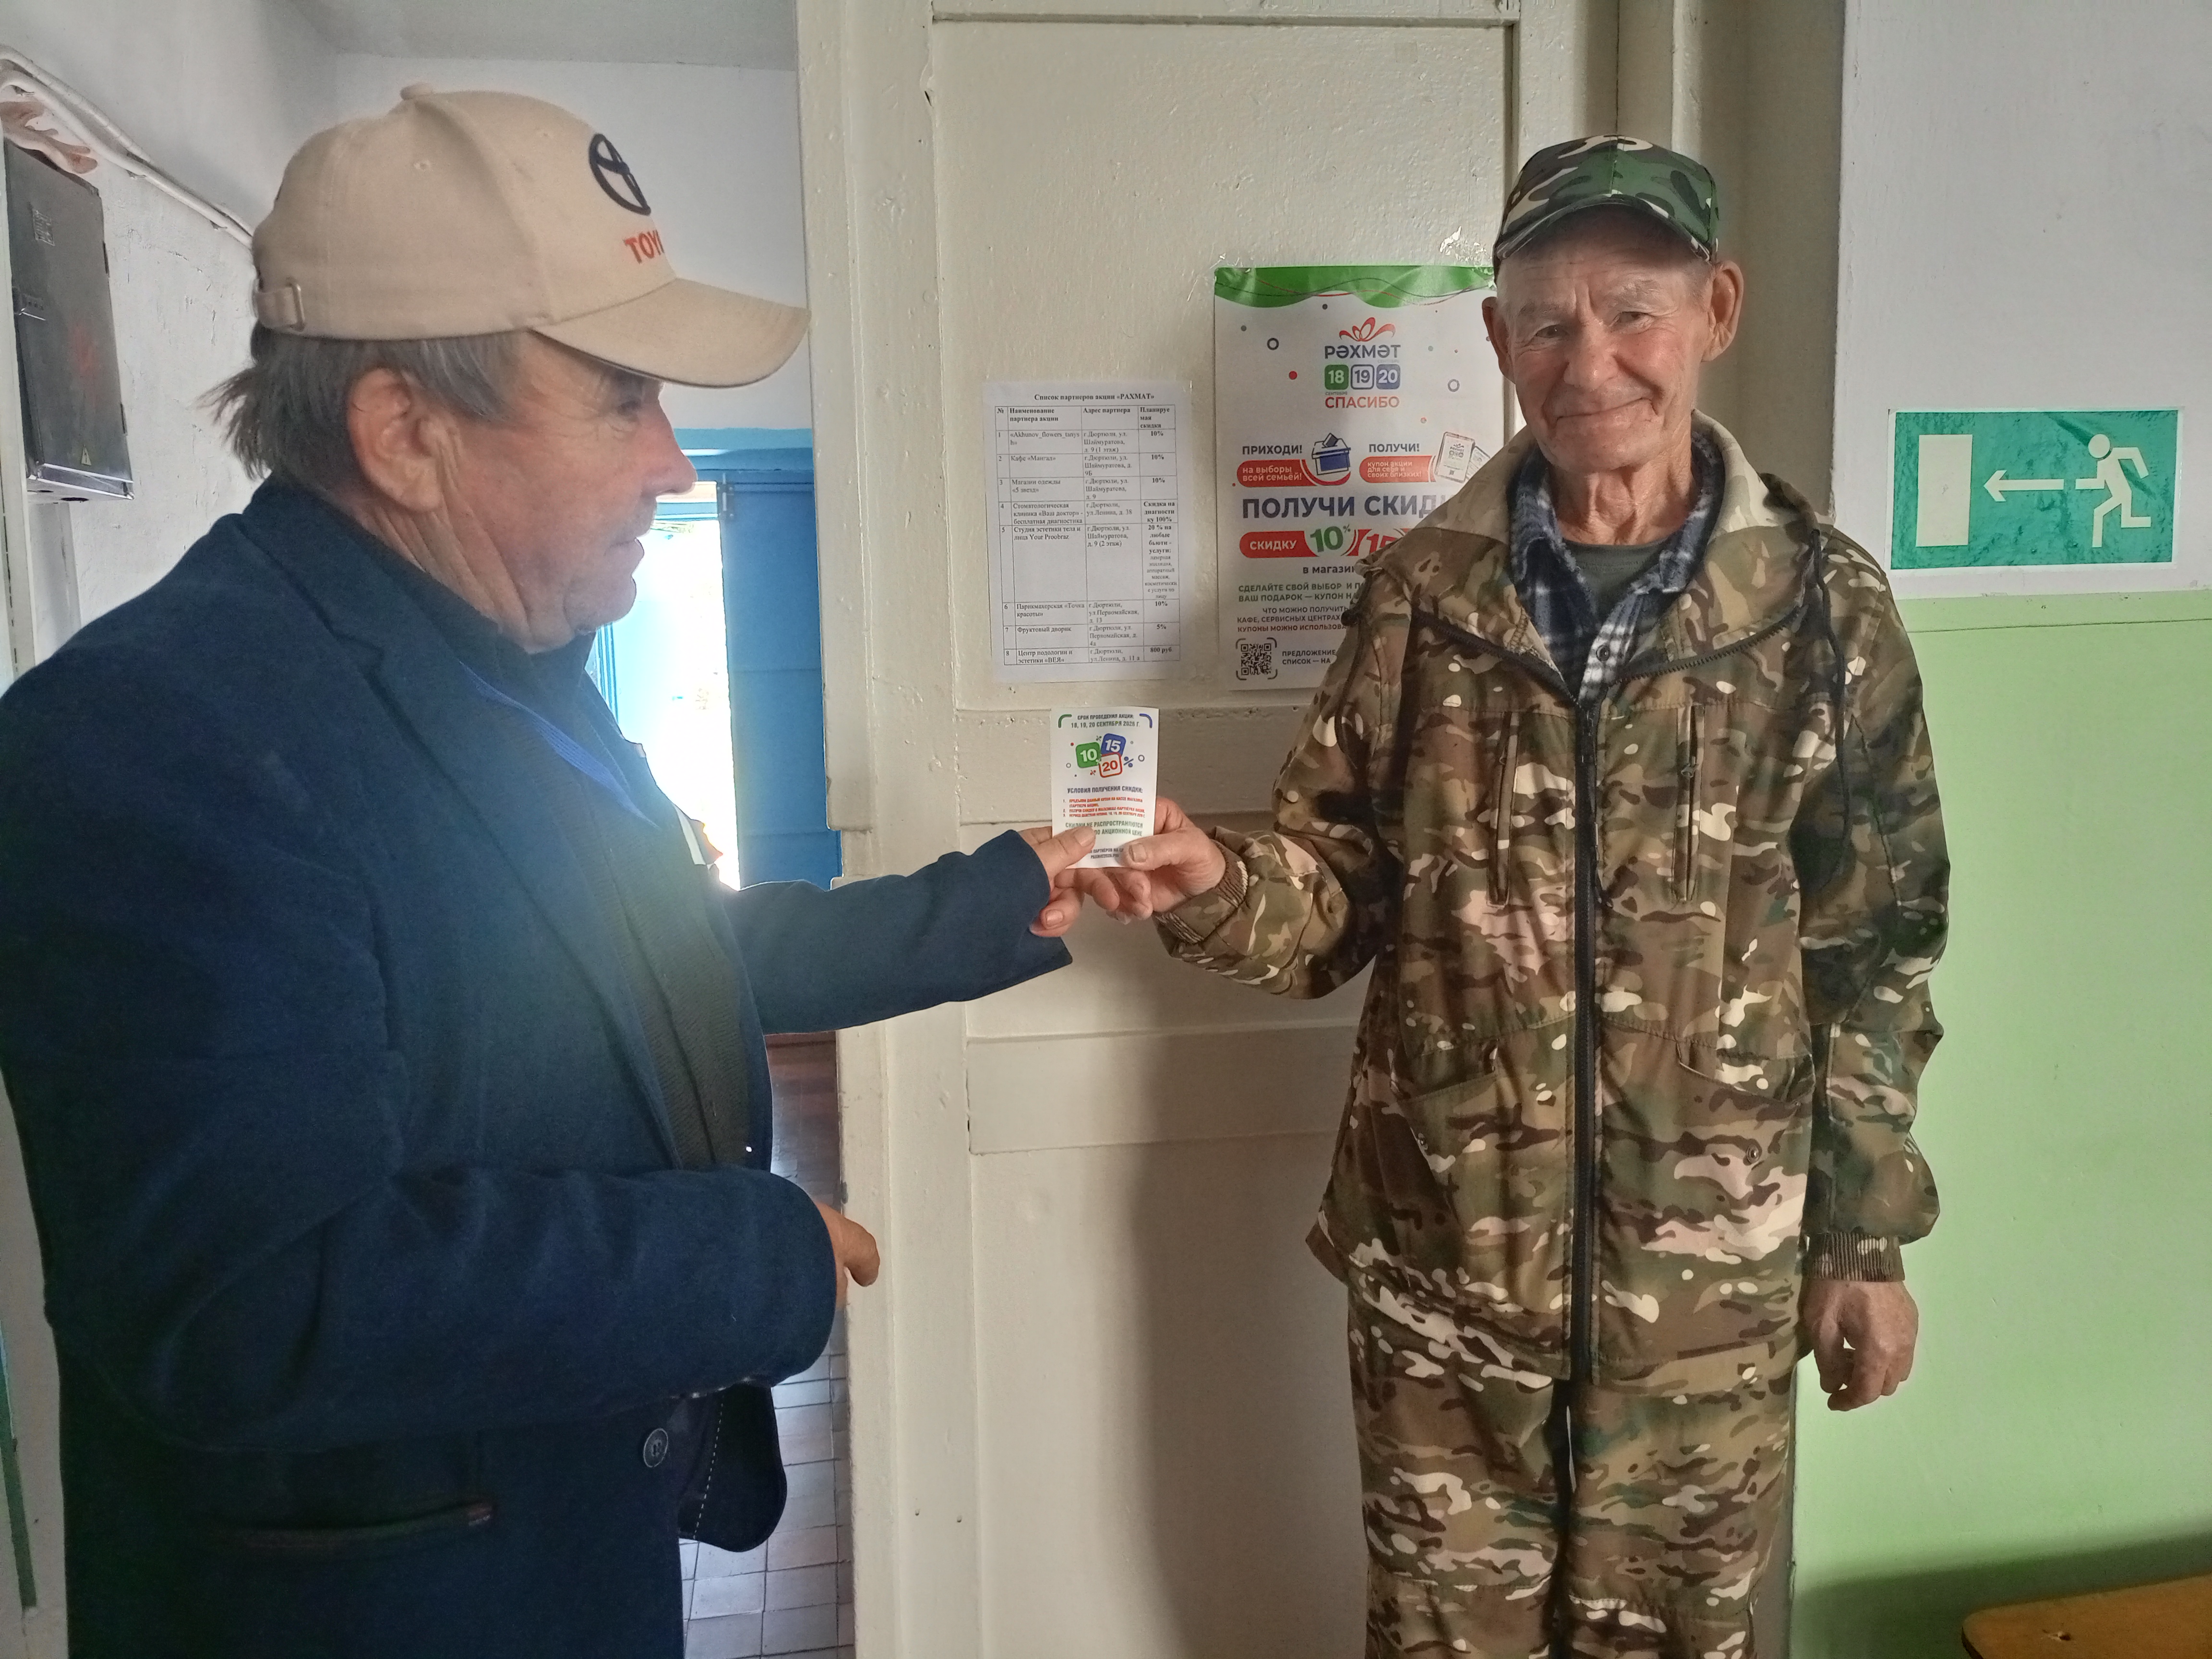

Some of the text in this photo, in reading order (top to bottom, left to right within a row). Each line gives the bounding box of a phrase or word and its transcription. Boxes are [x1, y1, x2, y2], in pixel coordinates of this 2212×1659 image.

[1325, 345, 1401, 359] РӘХМӘТ
[1328, 369, 1398, 384] 18 19 20
[1325, 397, 1400, 408] СПАСИБО
[1242, 445, 1302, 455] ПРИХОДИ!
[1369, 444, 1419, 452] ПОЛУЧИ!
[1243, 497, 1354, 518] ПОЛУЧИ
[1250, 540, 1297, 551] СКИДКУ
[1239, 583, 1283, 593] СДЕЛАЙТЕ
[1286, 582, 1309, 590] СВОЙ
[1106, 740, 1121, 752] 15
[1080, 748, 1097, 762] 10
[1102, 760, 1118, 772] 20
